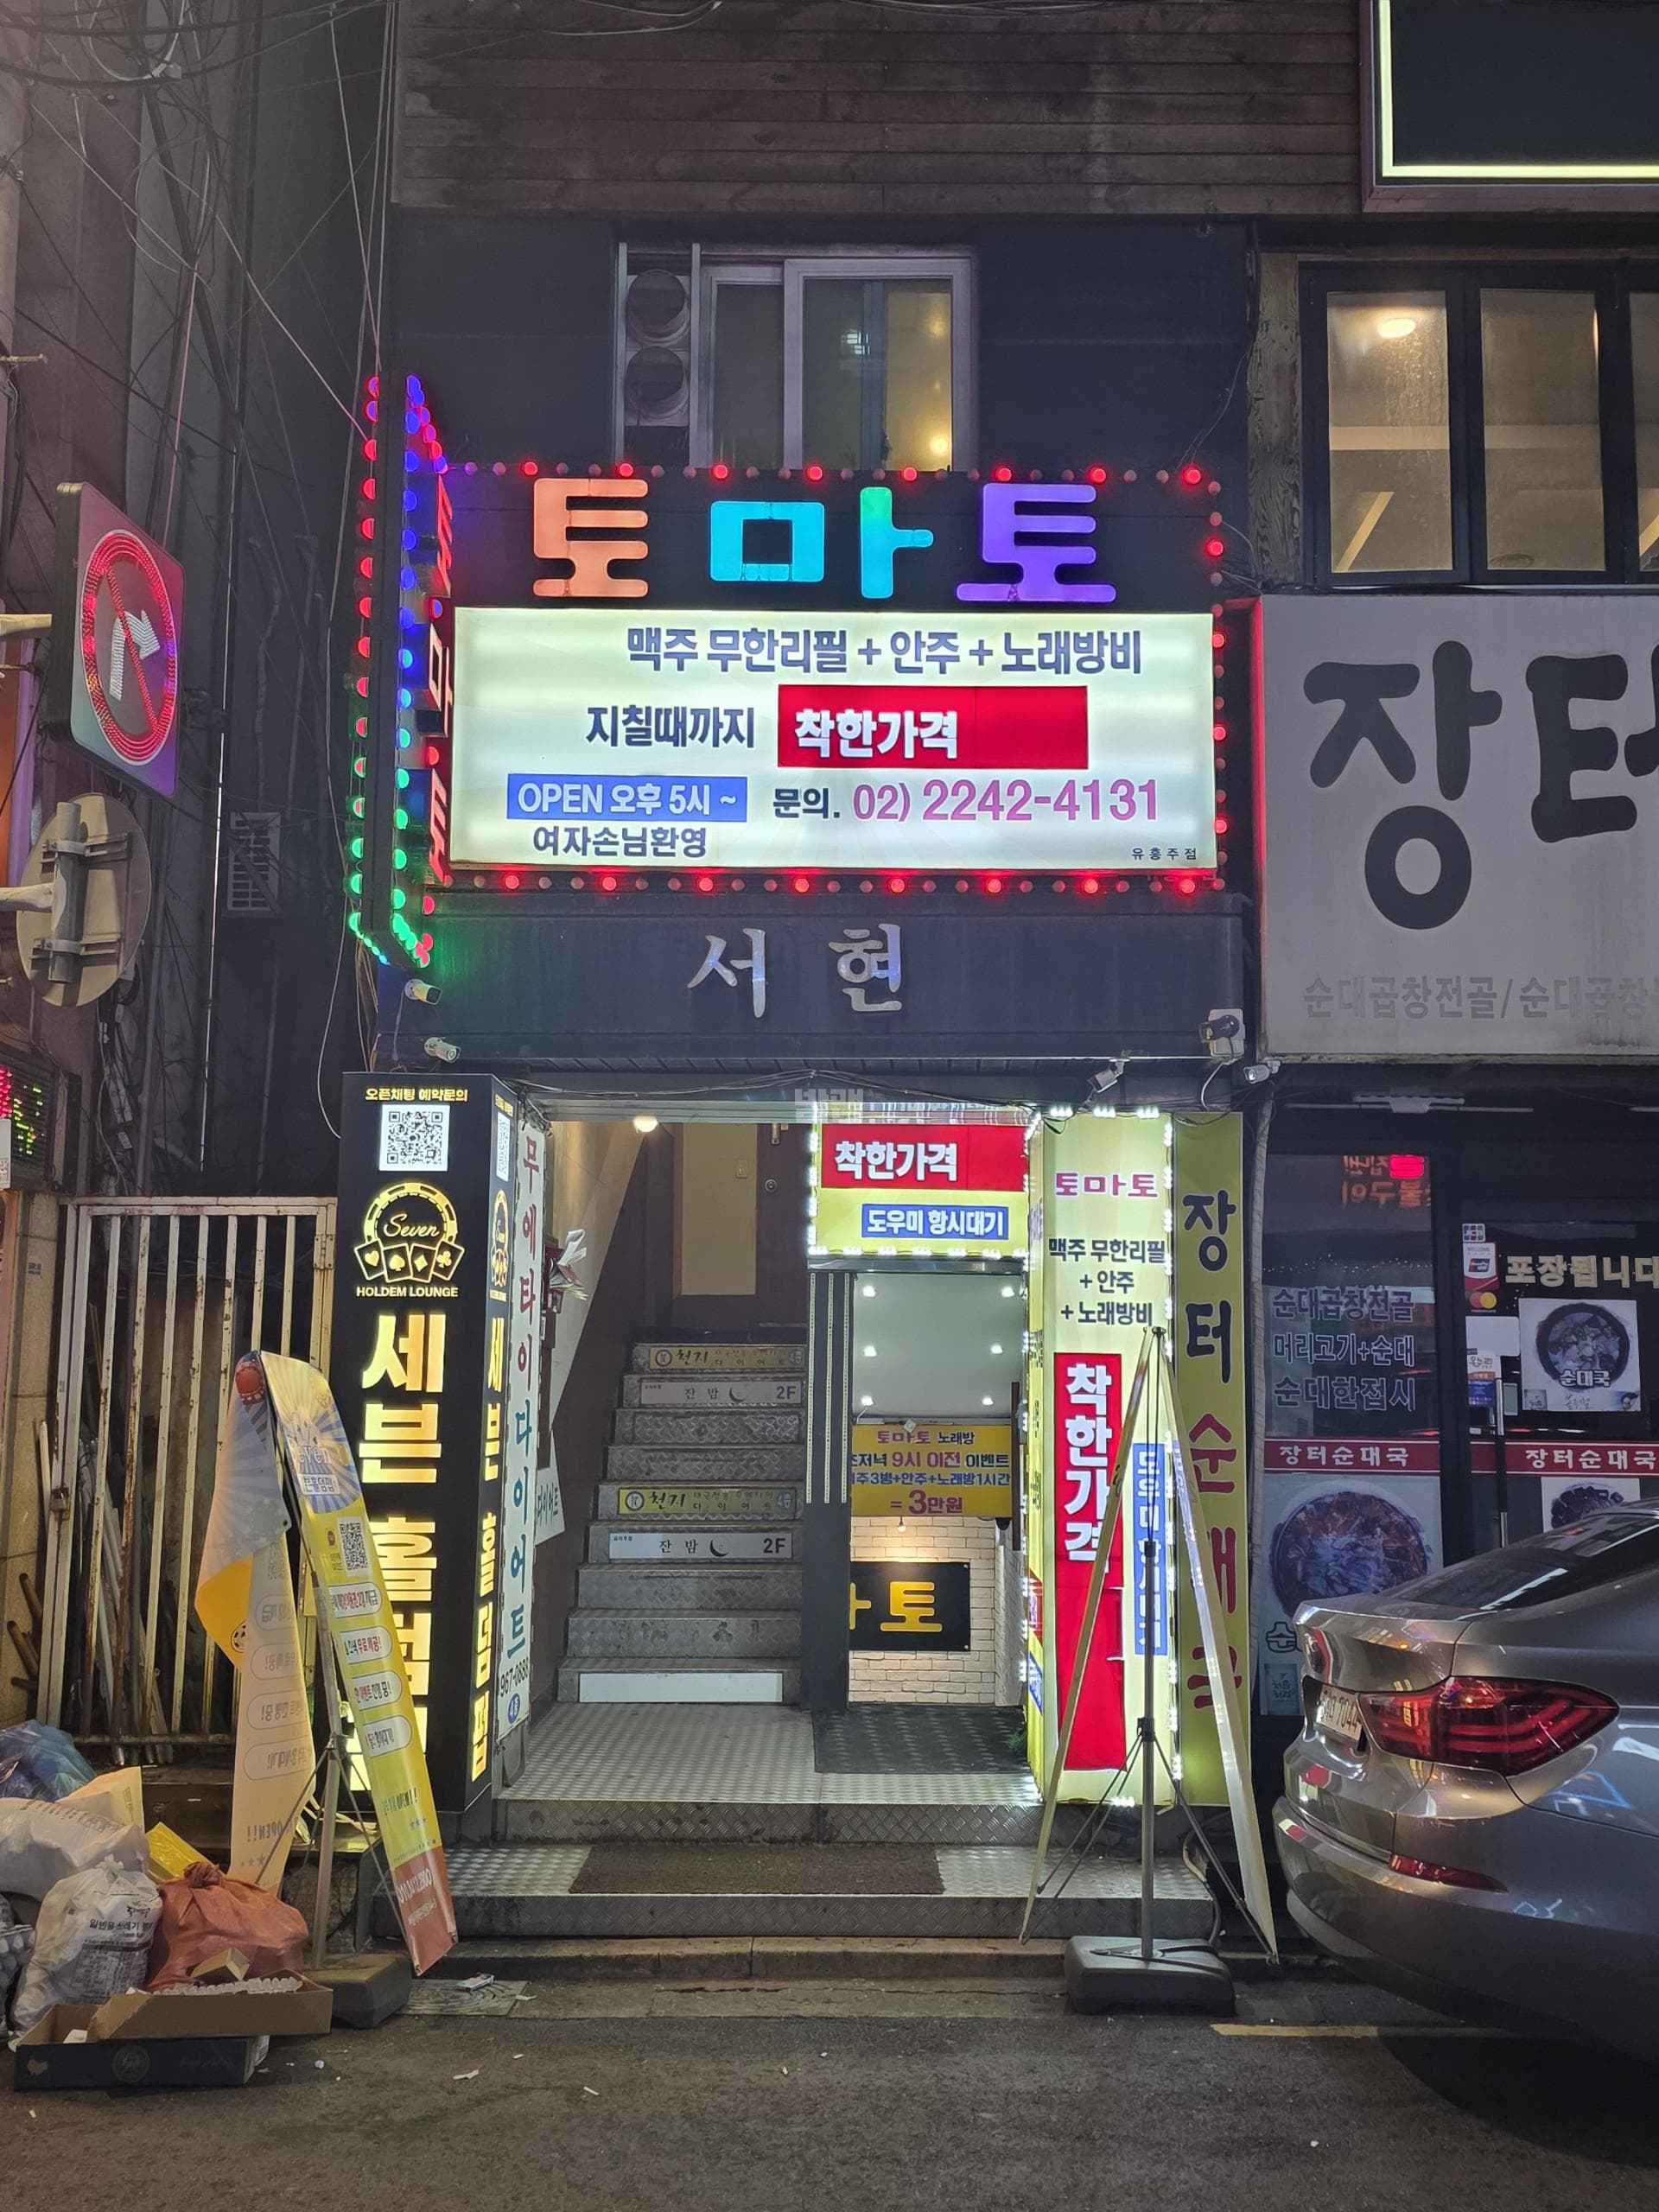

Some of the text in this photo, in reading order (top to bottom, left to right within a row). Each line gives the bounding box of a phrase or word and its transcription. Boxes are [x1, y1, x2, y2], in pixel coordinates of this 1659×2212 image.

[533, 477, 1117, 603] 토마토
[627, 627, 1142, 676] 맥주 무한리필 + 안주 + 노래방비
[586, 704, 959, 760] 지칠때까지 착한가격
[518, 783, 605, 814] OPEN
[610, 782, 663, 816] 오후
[669, 782, 712, 816] 5시
[772, 786, 840, 819] 문의.
[853, 783, 911, 823] 02)
[921, 778, 1158, 822] 2242-4131
[532, 825, 707, 859] 여자손님환영
[1131, 846, 1198, 861] 유흥주점
[1303, 976, 1659, 1020] 순대곱창전골/순대곱창
[365, 1087, 468, 1103] 오픈채팅 예약문의
[835, 1141, 957, 1182] 착한가격
[1056, 1173, 1159, 1198] 토마토
[384, 1213, 441, 1237] Seven
[867, 1210, 924, 1235] 도우미
[928, 1211, 1003, 1236] 항시대기
[518, 1135, 540, 1392] 무에타이
[1048, 1237, 1166, 1264] 맥주 무한리필
[356, 1287, 459, 1298] HOLDEM LOUNGE
[1097, 1270, 1135, 1294] 안주
[1078, 1301, 1154, 1327] 노래방비
[1273, 1287, 1415, 1323] 순대곱창전골
[1273, 1332, 1416, 1367] 머리고기+순대
[1559, 1369, 1611, 1388] 순대국
[359, 1313, 447, 1484] 세븐
[485, 1317, 505, 1482] 세븐
[776, 1385, 797, 1400] 2F
[1273, 1376, 1416, 1412] 순대한접시
[877, 1431, 975, 1444] 토마토 노래방
[892, 1451, 921, 1468] 9시
[926, 1451, 961, 1468] 이전
[966, 1453, 1010, 1468] 이벤트
[1280, 1446, 1409, 1466] 장터순대국
[1525, 1448, 1656, 1471] 장터순대국
[650, 1491, 686, 1510] 천지
[908, 1489, 963, 1515] 3만원
[763, 1537, 786, 1554] 2F
